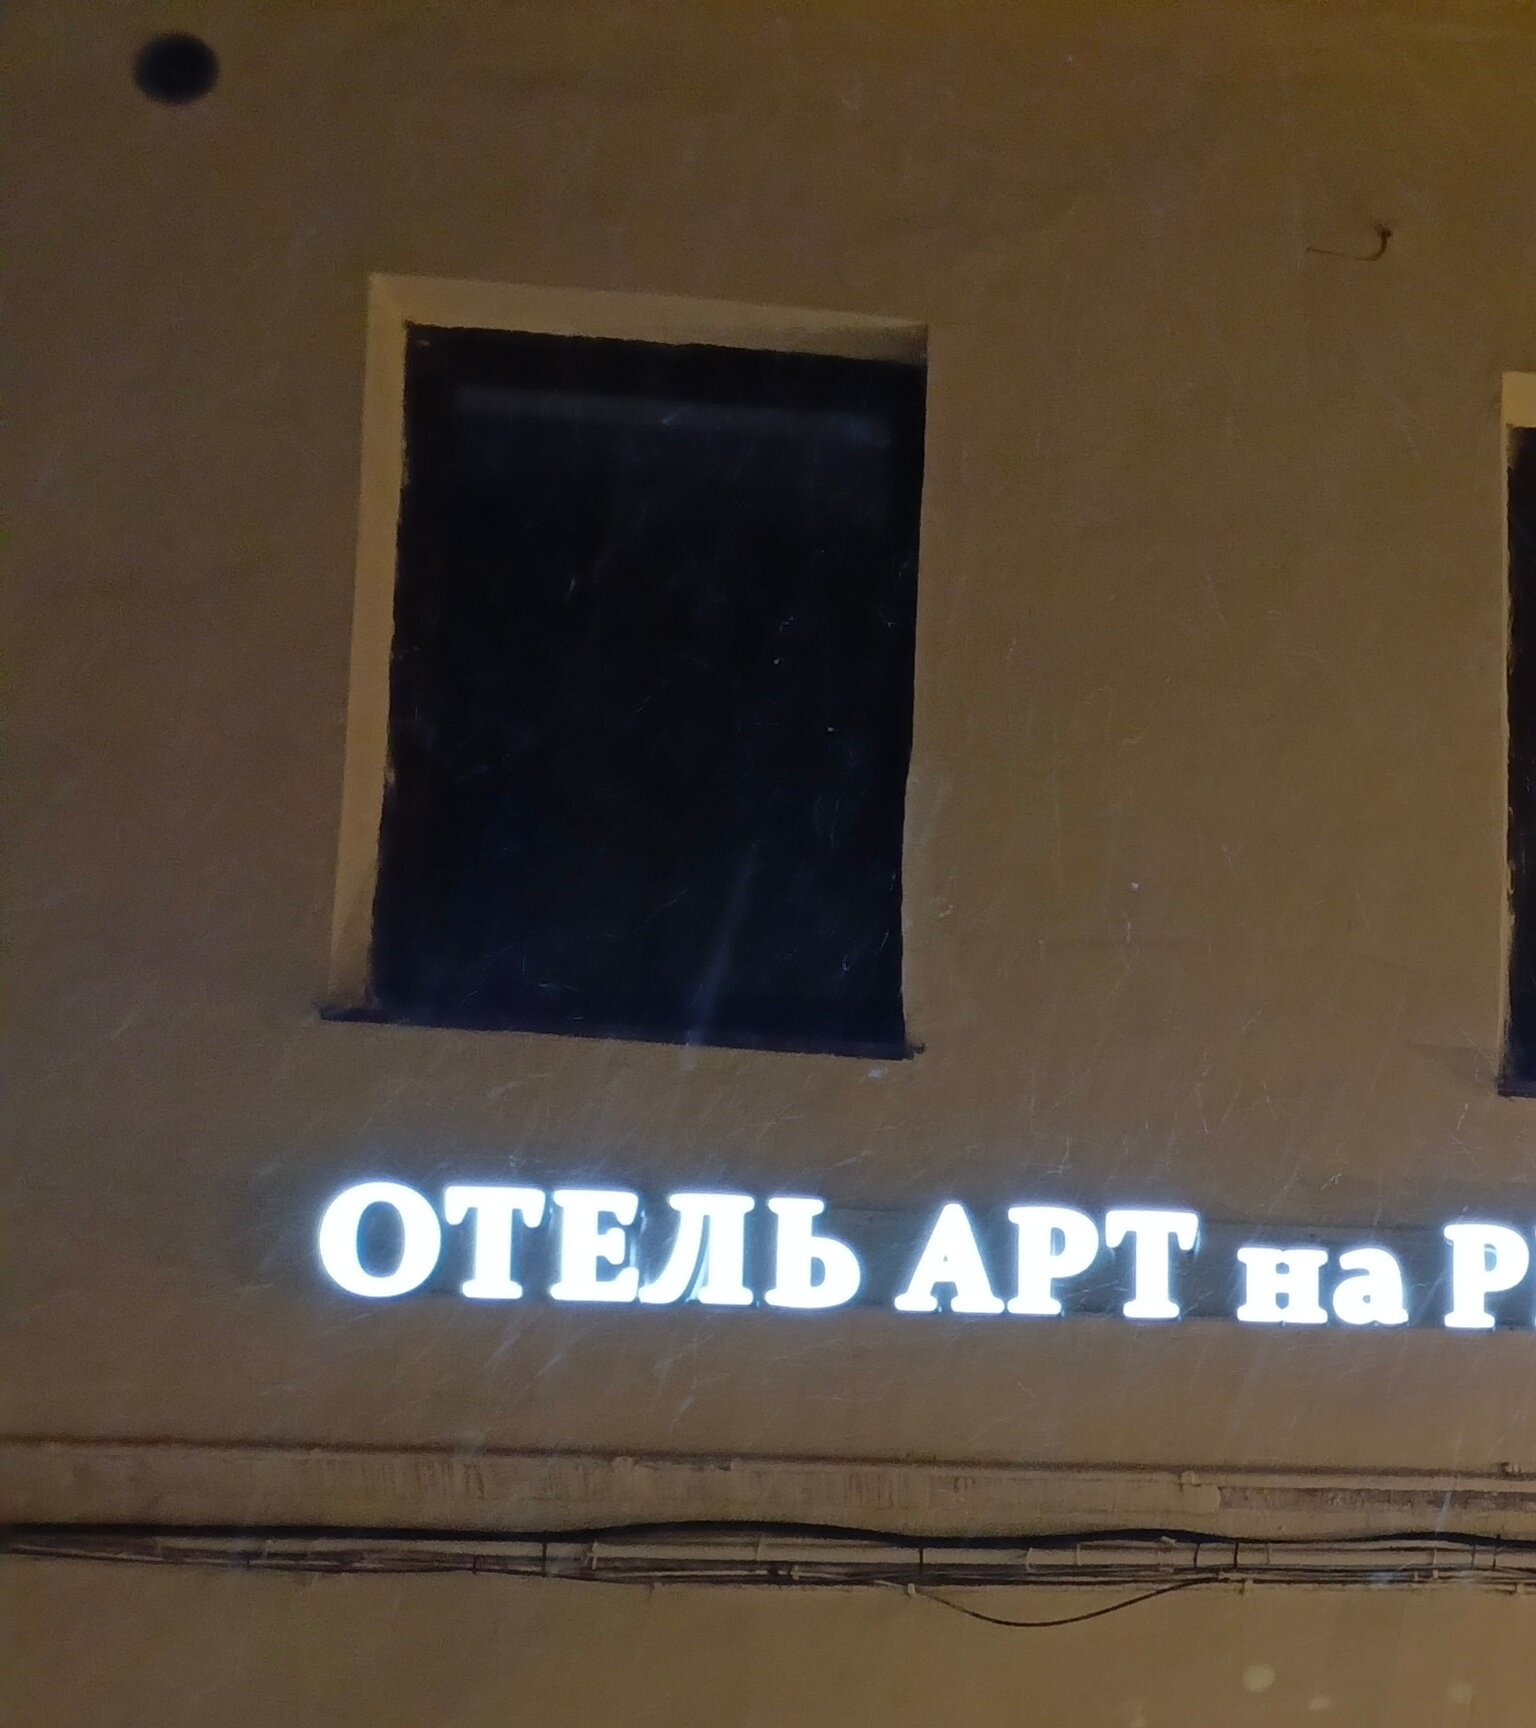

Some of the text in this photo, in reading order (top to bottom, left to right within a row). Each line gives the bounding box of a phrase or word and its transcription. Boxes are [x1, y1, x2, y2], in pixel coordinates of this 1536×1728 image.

[317, 1180, 863, 1310] ОТЕЛЬ
[893, 1202, 1200, 1320] АРТ
[1236, 1245, 1410, 1326] на
